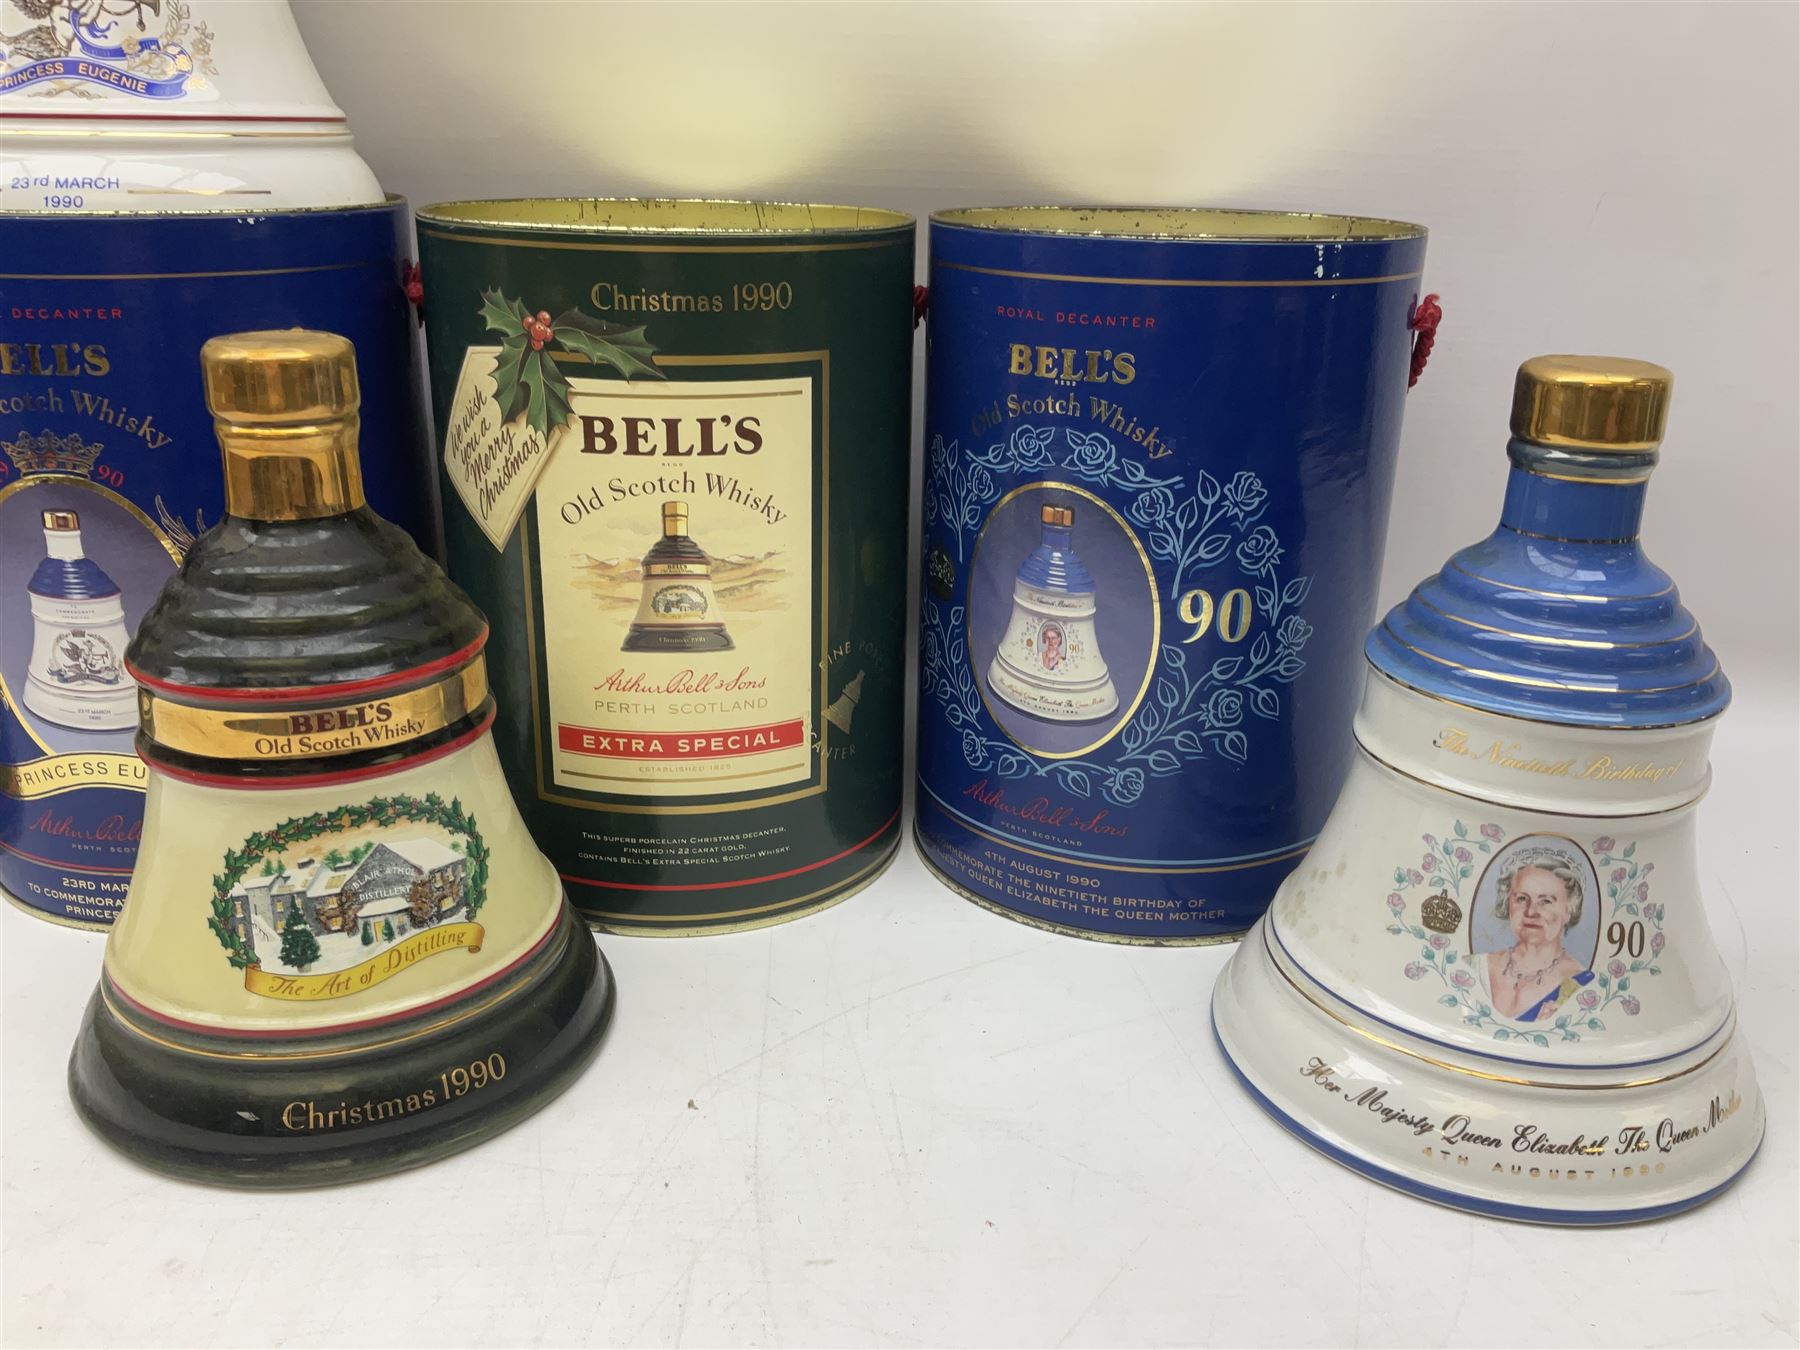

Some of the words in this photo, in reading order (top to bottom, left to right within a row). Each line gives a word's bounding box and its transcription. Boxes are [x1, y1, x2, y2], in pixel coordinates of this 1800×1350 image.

[78, 64, 148, 93] EUGENIE
[55, 177, 120, 190] MARCH
[43, 196, 84, 208] 1990
[590, 281, 723, 312] Christmas
[732, 281, 793, 311] 1990
[12, 308, 123, 319] DECANTER
[997, 306, 1044, 321] ROYAL
[1056, 312, 1156, 328] DECANTER
[0, 343, 111, 377] ELL'S
[1008, 343, 1136, 385] BELL'S
[0, 387, 65, 415] cotch
[70, 389, 173, 449] Whisky
[970, 400, 1003, 437] Old
[1006, 392, 1082, 418] Scotch
[1089, 396, 1173, 460] Whisky
[460, 432, 481, 482] you
[481, 416, 491, 434] a
[579, 414, 763, 456] BELL'S
[470, 427, 516, 489] Merry
[98, 464, 125, 488] 90
[479, 434, 539, 520] Christmas
[561, 486, 604, 525] Old
[608, 471, 696, 502] Scotch
[705, 472, 787, 525] Whisky
[1177, 588, 1252, 644] 90
[1069, 643, 1080, 654] 90
[594, 667, 666, 694] Arthur
[666, 669, 717, 694] Bell
[724, 666, 767, 691] Sons
[289, 702, 393, 735] BELL'S
[594, 700, 656, 715] PERTH
[668, 697, 768, 715] SCOTLAND
[255, 738, 292, 755] Old
[299, 728, 361, 754] Scotch
[364, 719, 426, 748] Whisky
[583, 734, 664, 752] EXTRA
[678, 731, 780, 752] SPECIAL
[15, 761, 109, 788] PRINCESS
[638, 765, 705, 773] ESTABLISHED
[71, 843, 102, 851] PERTH
[603, 836, 636, 844] SUPERB
[1000, 820, 1027, 834] PERTH
[1032, 830, 1083, 847] SCOTLAND
[578, 852, 618, 862] CONTAINS
[623, 847, 664, 855] FINISHED
[352, 868, 381, 891] BLAIR
[984, 850, 1006, 864] 4TH
[1009, 859, 1061, 881] AUGUST
[1066, 873, 1101, 889] 1990
[28, 882, 41, 895] TO
[44, 888, 125, 908] COMMEMORA
[62, 877, 96, 891] 23RD
[100, 880, 130, 893] MAR
[359, 886, 412, 902] DISTILLERY
[967, 868, 1003, 891] QUEEN
[1007, 886, 1078, 913] ELIZABETH
[1082, 907, 1110, 918] THE
[1114, 908, 1164, 922] QUEEN
[1169, 908, 1225, 922] MOTHER
[1007, 873, 1031, 889] THE
[1035, 881, 1108, 905] NINETIETH
[1112, 896, 1183, 909] BIRTHDAY
[1187, 898, 1206, 908] OF
[66, 904, 118, 920] PRINCES
[1606, 920, 1645, 958] 90
[268, 976, 304, 997] The
[311, 975, 352, 997] Art
[360, 965, 376, 985] of
[386, 929, 467, 973] Distilling
[282, 1089, 435, 1131] Christmas
[441, 1052, 507, 1100] 1990
[1300, 1056, 1341, 1093] Her
[1344, 1086, 1436, 1136] Majesty
[1441, 1113, 1503, 1149] Queen
[1510, 1124, 1609, 1156] Elizabeth
[1615, 1126, 1650, 1156] The
[1656, 1118, 1700, 1153] Queen
